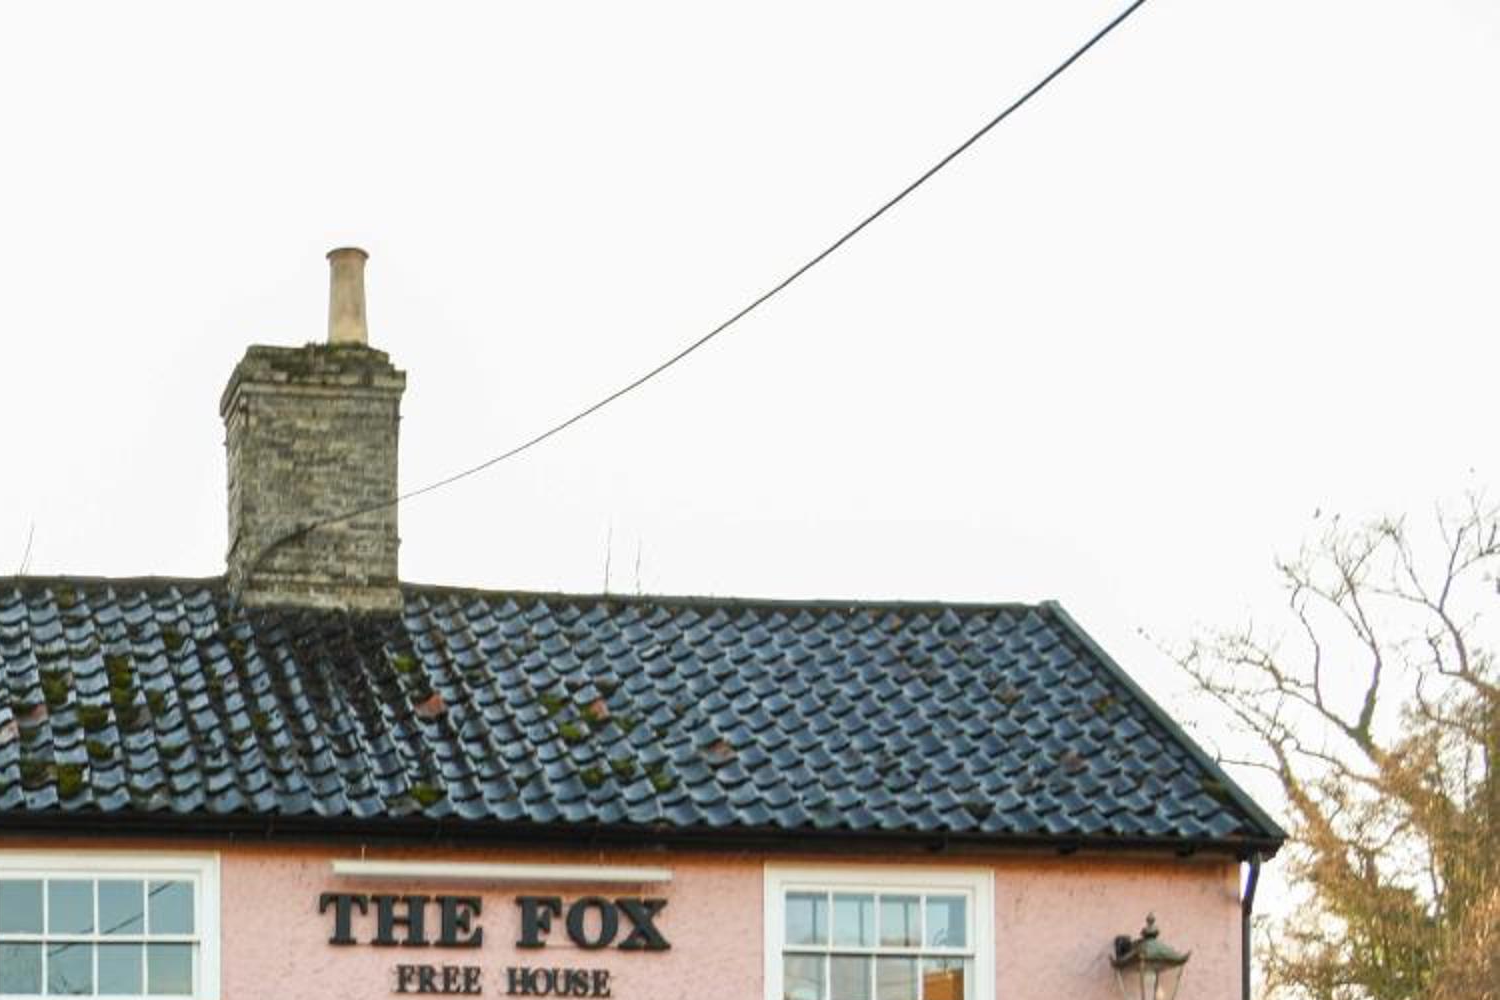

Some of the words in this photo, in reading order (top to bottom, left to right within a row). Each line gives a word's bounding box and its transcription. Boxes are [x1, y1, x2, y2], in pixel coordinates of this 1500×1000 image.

[319, 891, 483, 948] THE
[515, 895, 671, 951] FOX
[396, 964, 482, 994] FREE
[506, 966, 611, 998] HOUSE
